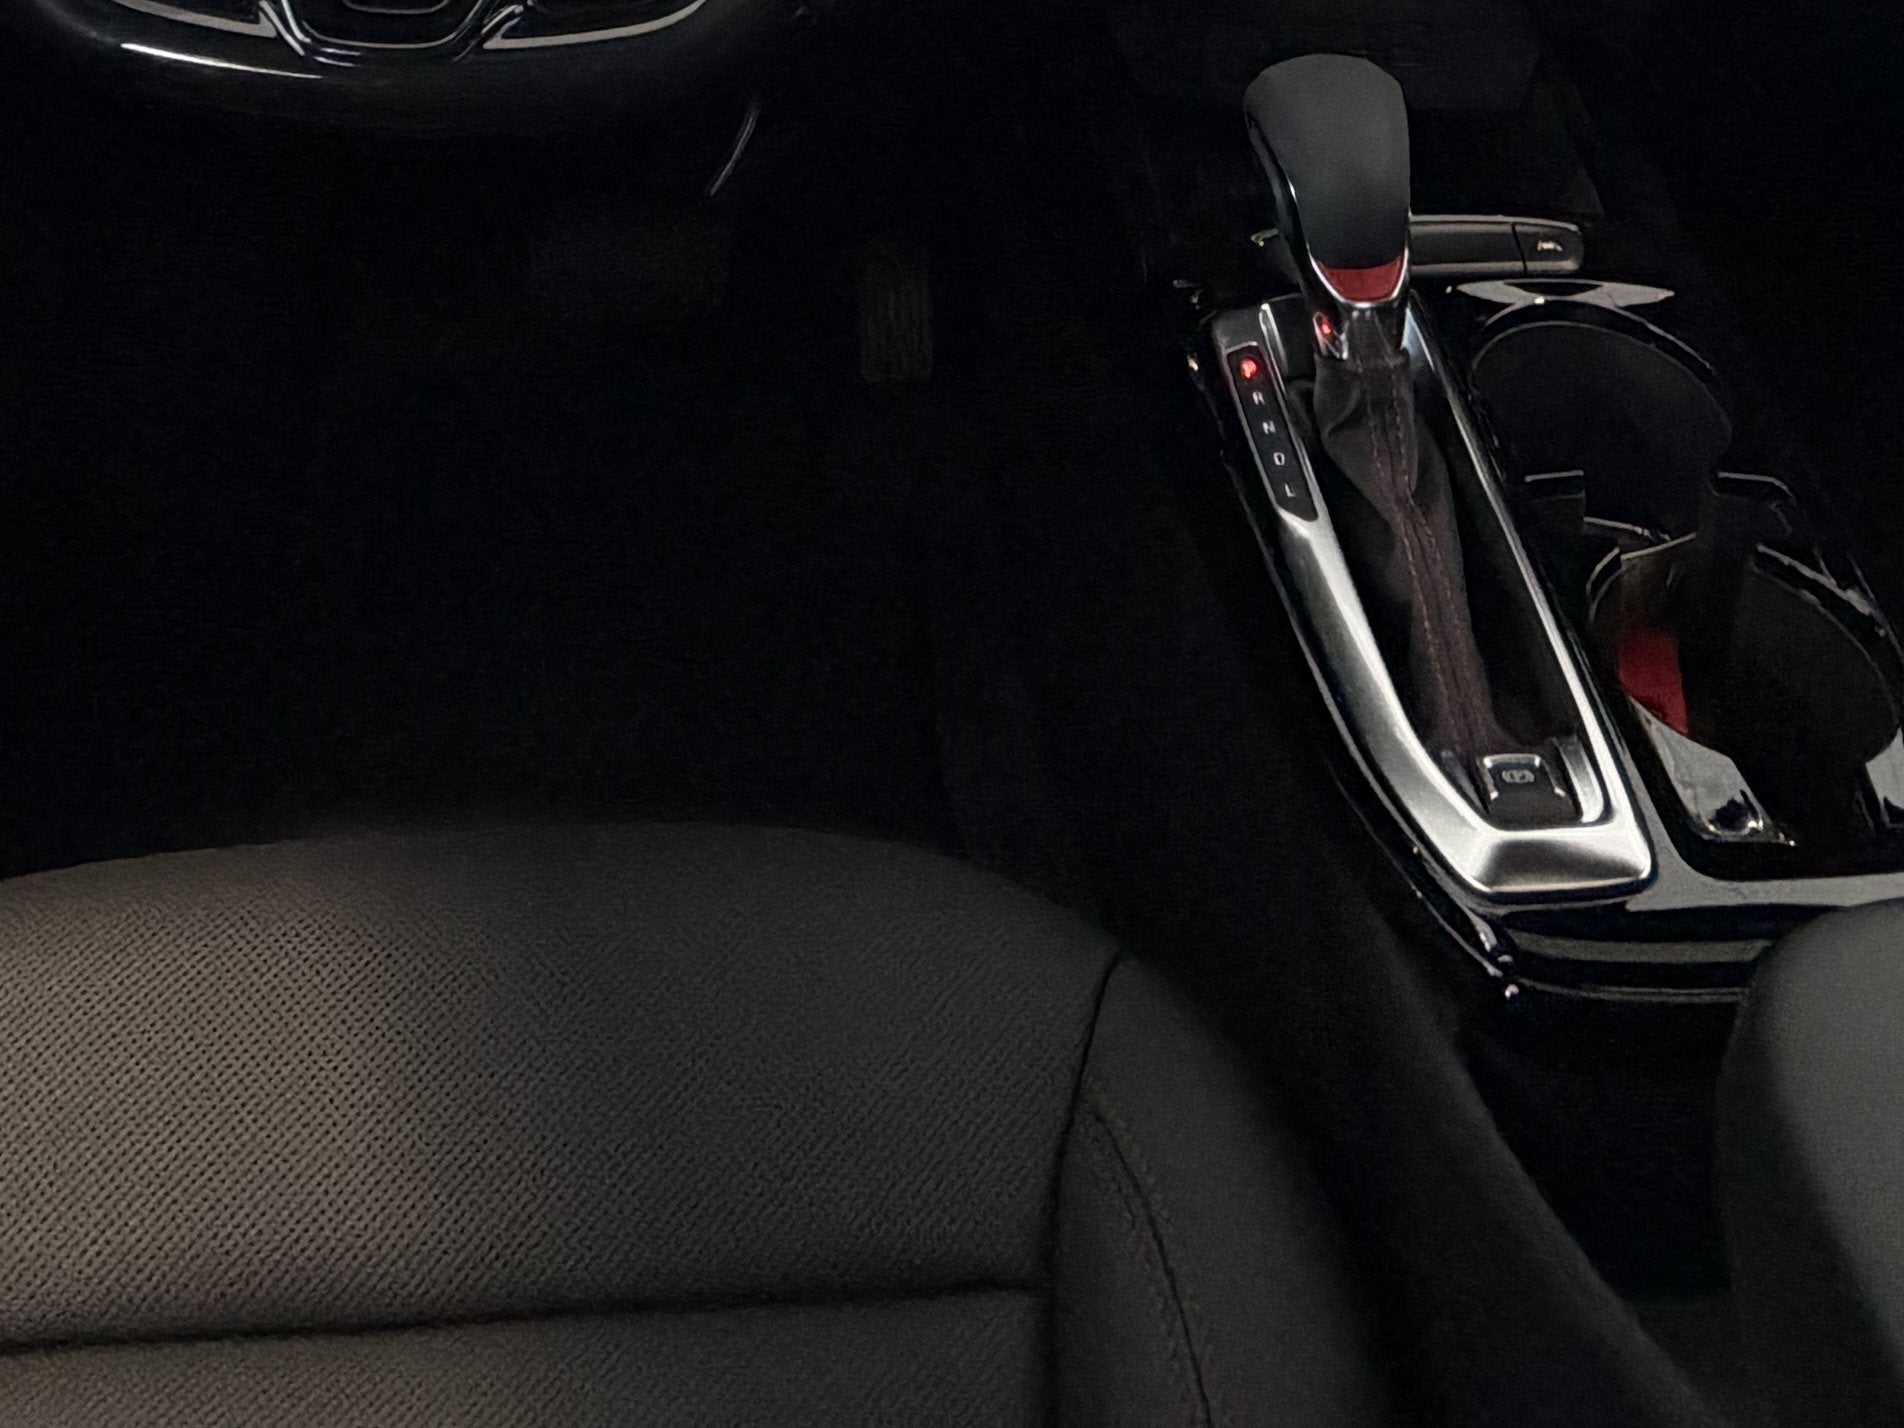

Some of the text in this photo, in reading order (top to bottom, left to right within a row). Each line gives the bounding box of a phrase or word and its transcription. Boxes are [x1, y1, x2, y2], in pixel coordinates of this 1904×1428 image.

[1252, 391, 1266, 406] R
[1263, 420, 1276, 435] N
[1284, 484, 1296, 498] L
